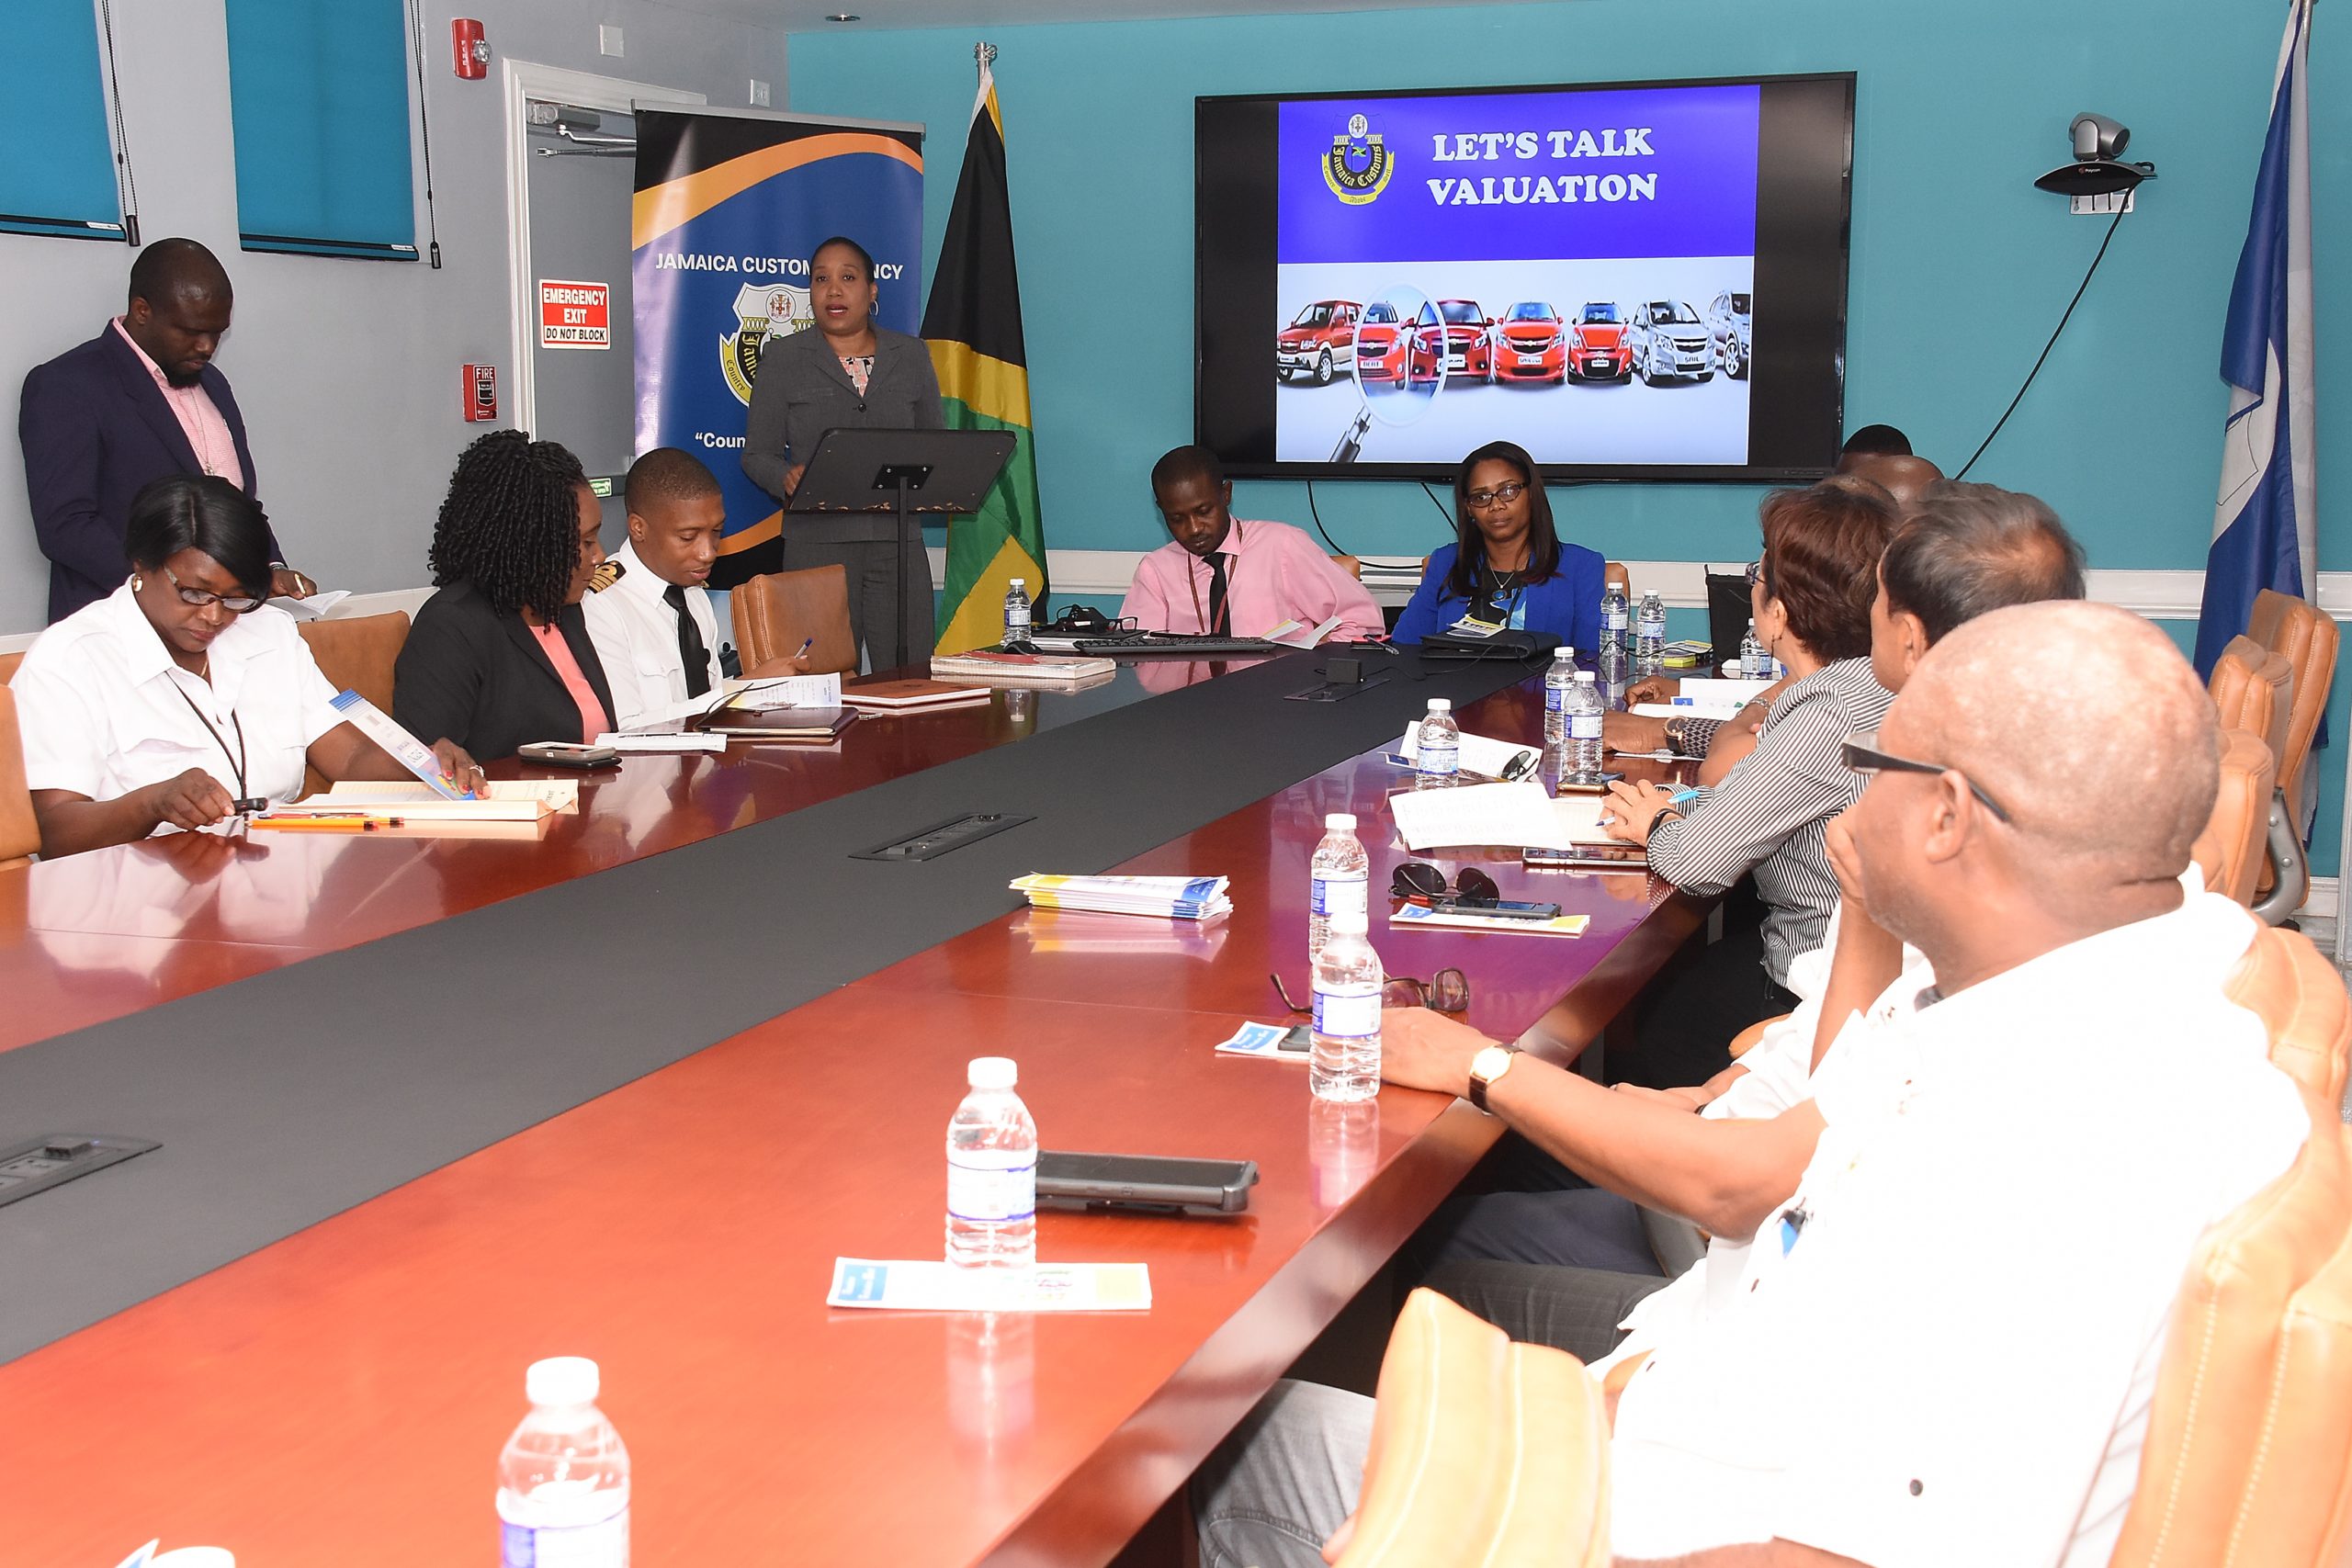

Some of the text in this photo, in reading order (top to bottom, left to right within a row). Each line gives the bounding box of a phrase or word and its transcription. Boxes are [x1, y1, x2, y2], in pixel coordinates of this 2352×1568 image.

[1432, 128, 1655, 162] LET'S TALK
[1333, 145, 1383, 186] Jamaica Customs
[1426, 173, 1658, 206] VALUATION
[655, 253, 739, 273] JAMAICA
[742, 256, 810, 276] CUSTOM
[543, 288, 605, 306] EMERGENCY
[563, 308, 587, 323] EXIT
[546, 328, 605, 341] DO NOT BLOCK
[476, 367, 493, 379] FIRE
[726, 359, 746, 391] Country
[695, 432, 746, 448] "Coun
